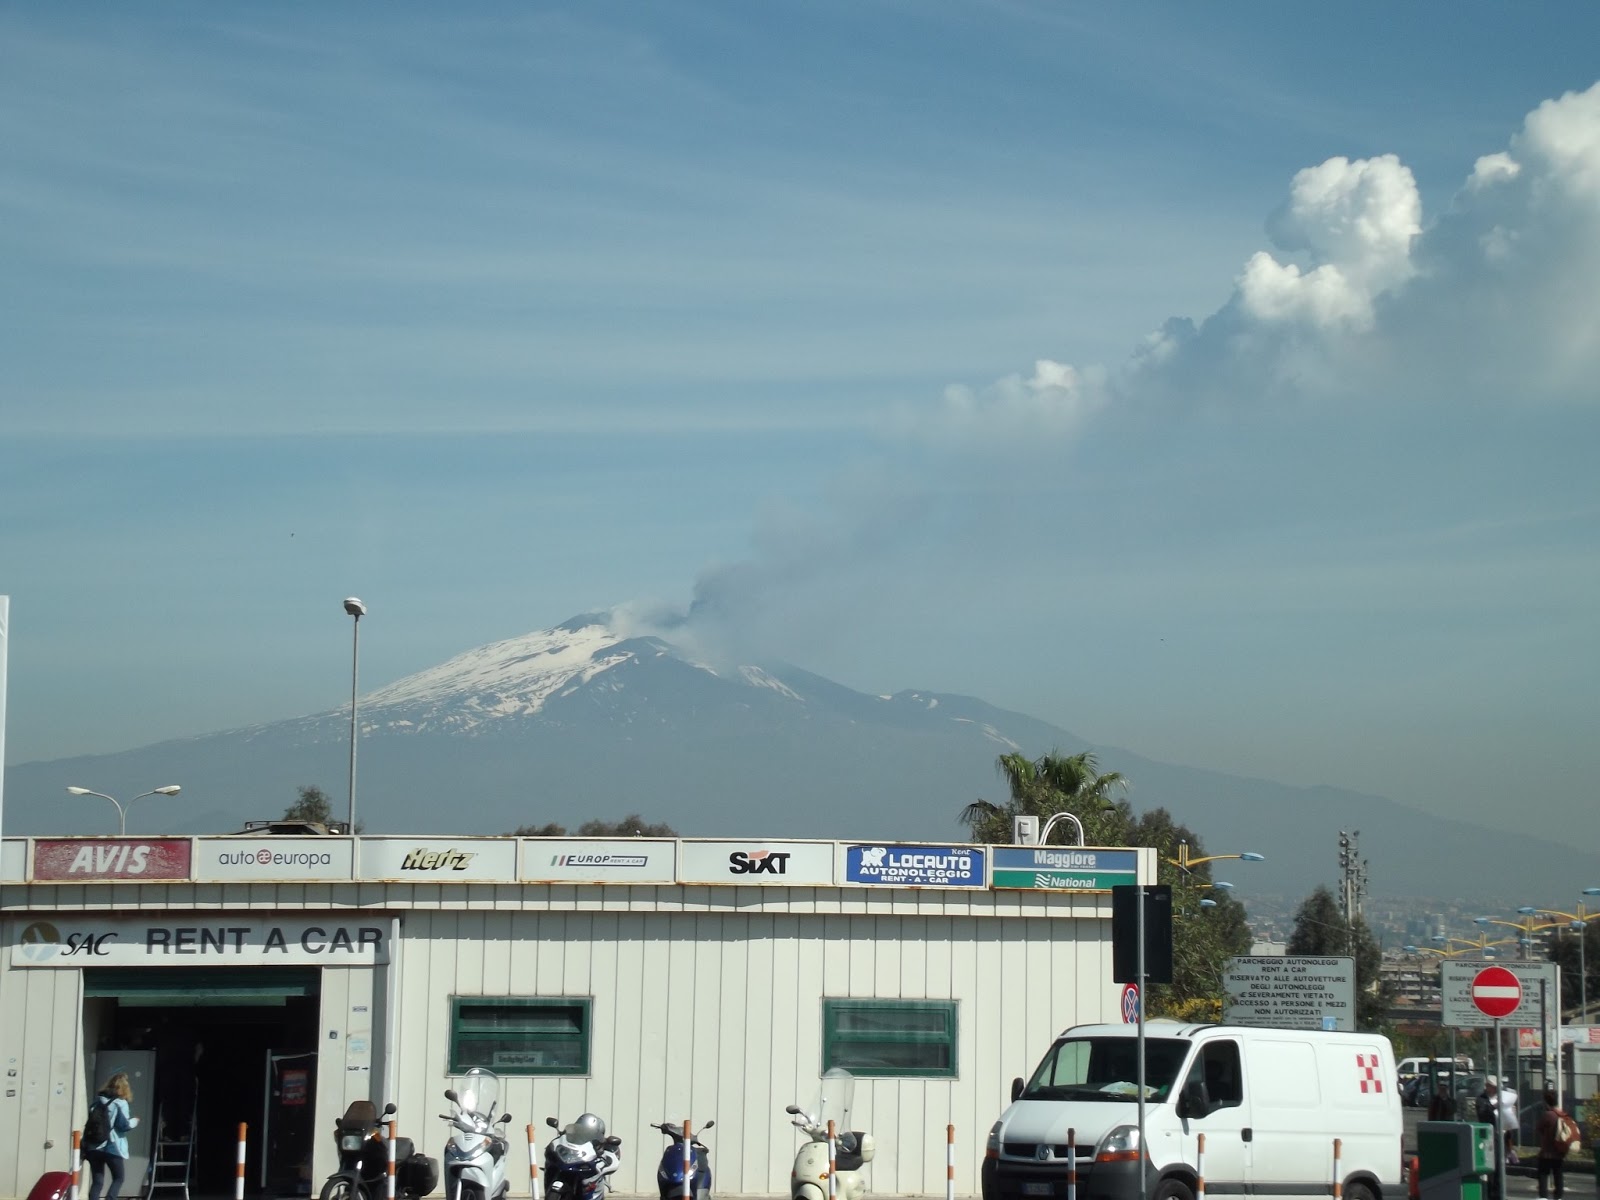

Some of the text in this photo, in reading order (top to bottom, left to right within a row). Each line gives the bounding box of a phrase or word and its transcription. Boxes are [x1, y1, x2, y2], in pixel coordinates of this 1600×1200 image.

[69, 846, 151, 873] AVIS
[401, 848, 475, 870] Hertz
[889, 853, 971, 870] LOCAUTO
[1034, 850, 1096, 868] Maggiore
[860, 867, 971, 878] AUTONOLEGGIO
[1051, 877, 1096, 888] National
[61, 927, 383, 956] SAC RENT A CAR
[1293, 975, 1347, 983] AUTOVETTURE
[1273, 983, 1325, 991] AUTONOLEGGI
[1248, 991, 1300, 999] SEVERAMENTE
